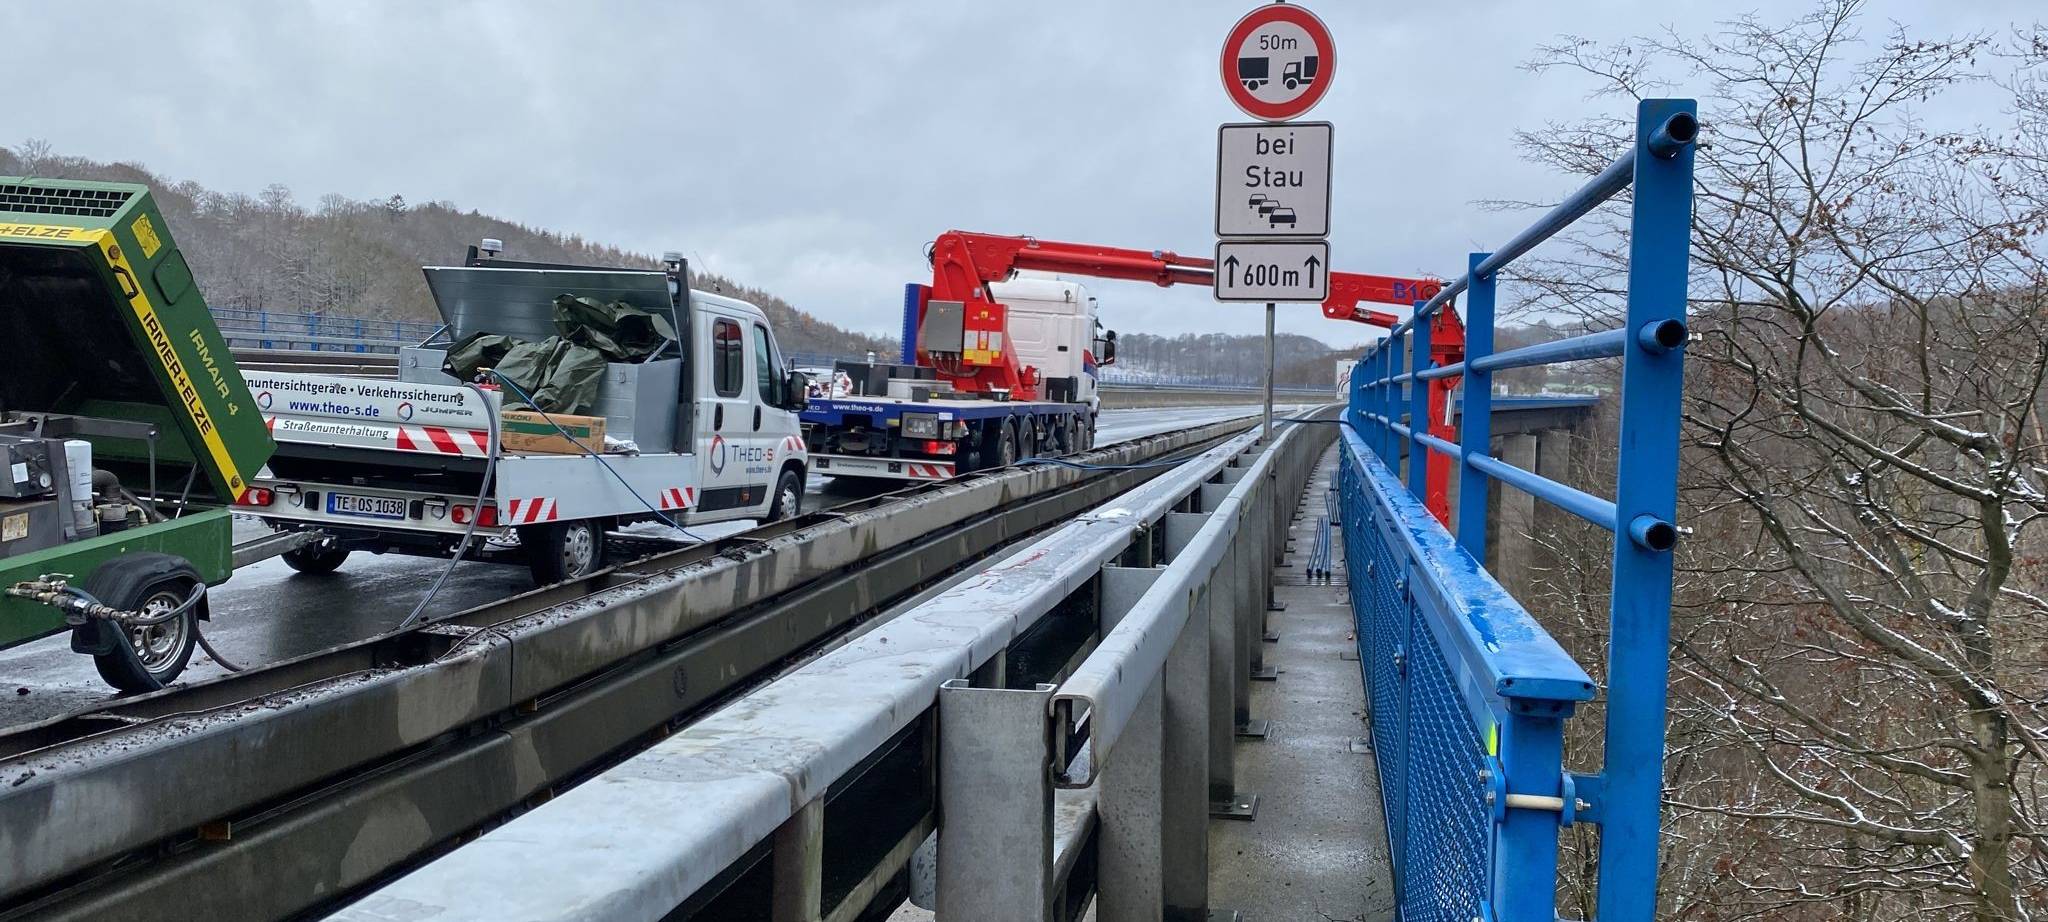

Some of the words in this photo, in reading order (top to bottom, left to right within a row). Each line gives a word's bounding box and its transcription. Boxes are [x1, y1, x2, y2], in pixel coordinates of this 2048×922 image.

[1260, 35, 1297, 50] 50m
[1256, 132, 1294, 155] bei
[1245, 166, 1303, 187] Stau
[1244, 264, 1299, 287] 600m
[143, 312, 212, 436] IRMER+ELZE
[189, 328, 230, 399] IRMAIR
[227, 402, 239, 415] 4
[357, 386, 464, 405] Verkehrssicherung
[289, 400, 380, 417] www.theo-s.de
[420, 407, 473, 416] JUMPER
[833, 404, 884, 413] www.theo-s.de
[283, 420, 389, 440] Straßenunterhaltung
[336, 497, 349, 511] TE
[358, 499, 373, 513] OS
[375, 500, 404, 515] 1038
